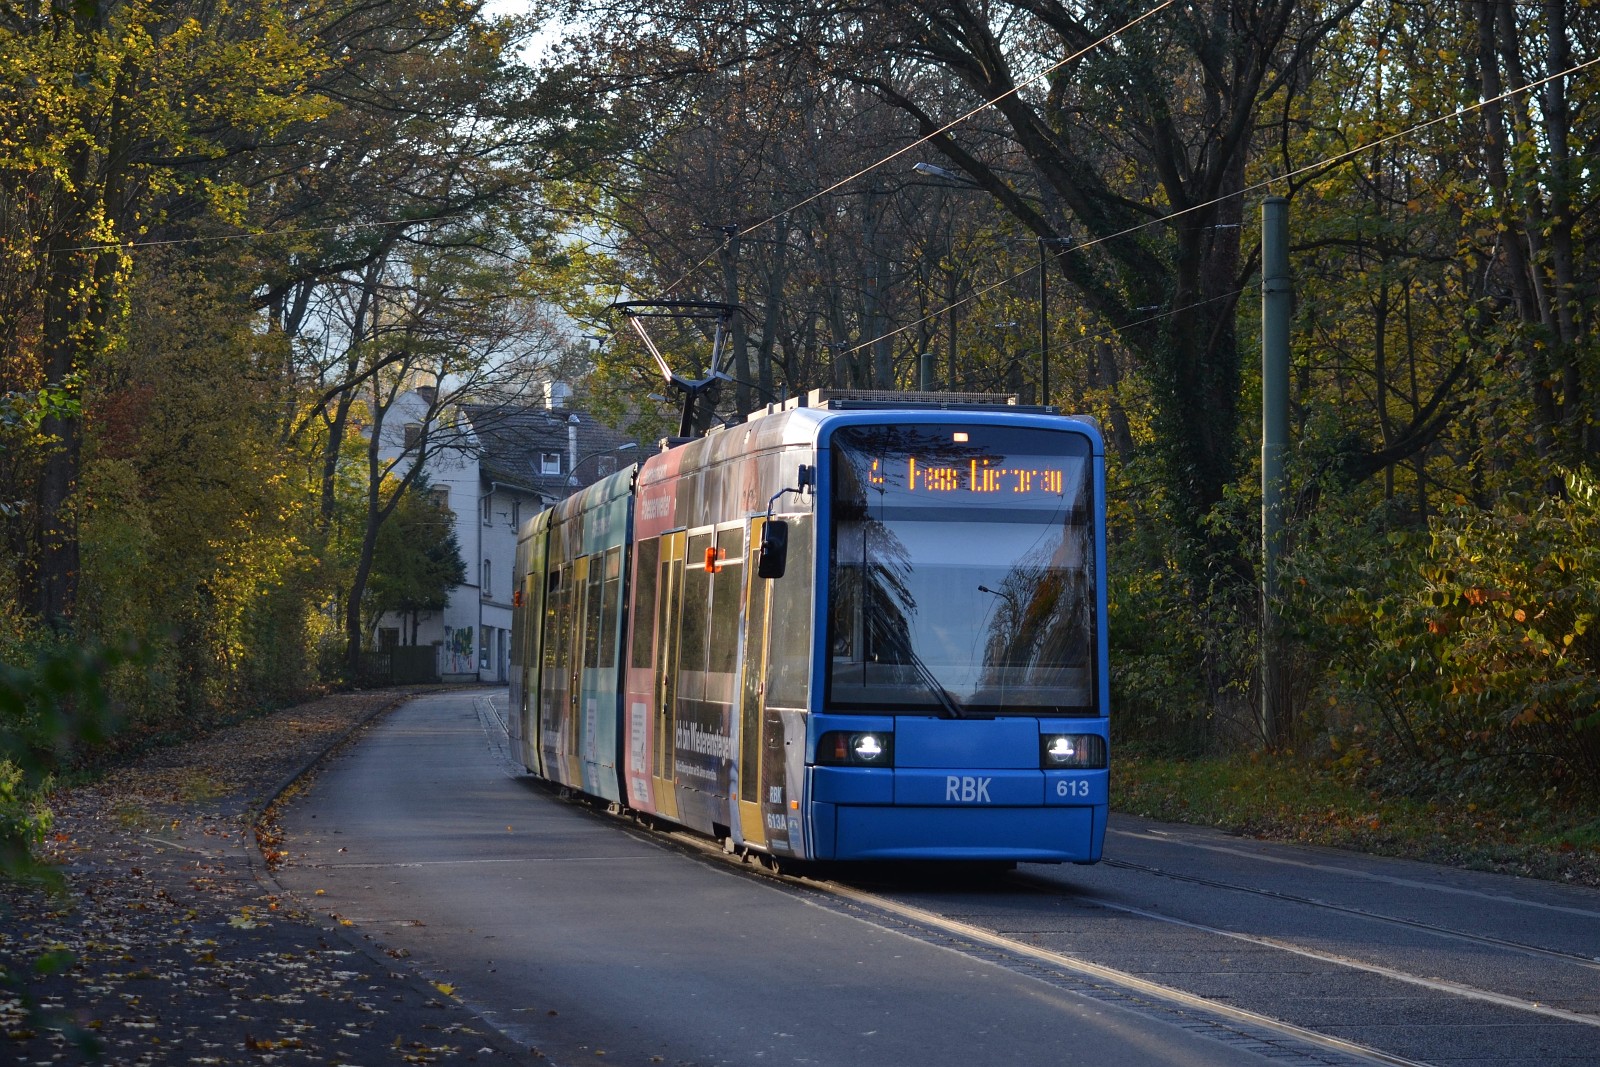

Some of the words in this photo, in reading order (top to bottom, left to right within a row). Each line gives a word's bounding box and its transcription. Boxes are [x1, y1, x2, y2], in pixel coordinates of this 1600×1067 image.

[769, 786, 783, 804] RBK
[945, 776, 992, 803] RBK
[1056, 780, 1089, 797] 613
[767, 813, 787, 830] 613A
